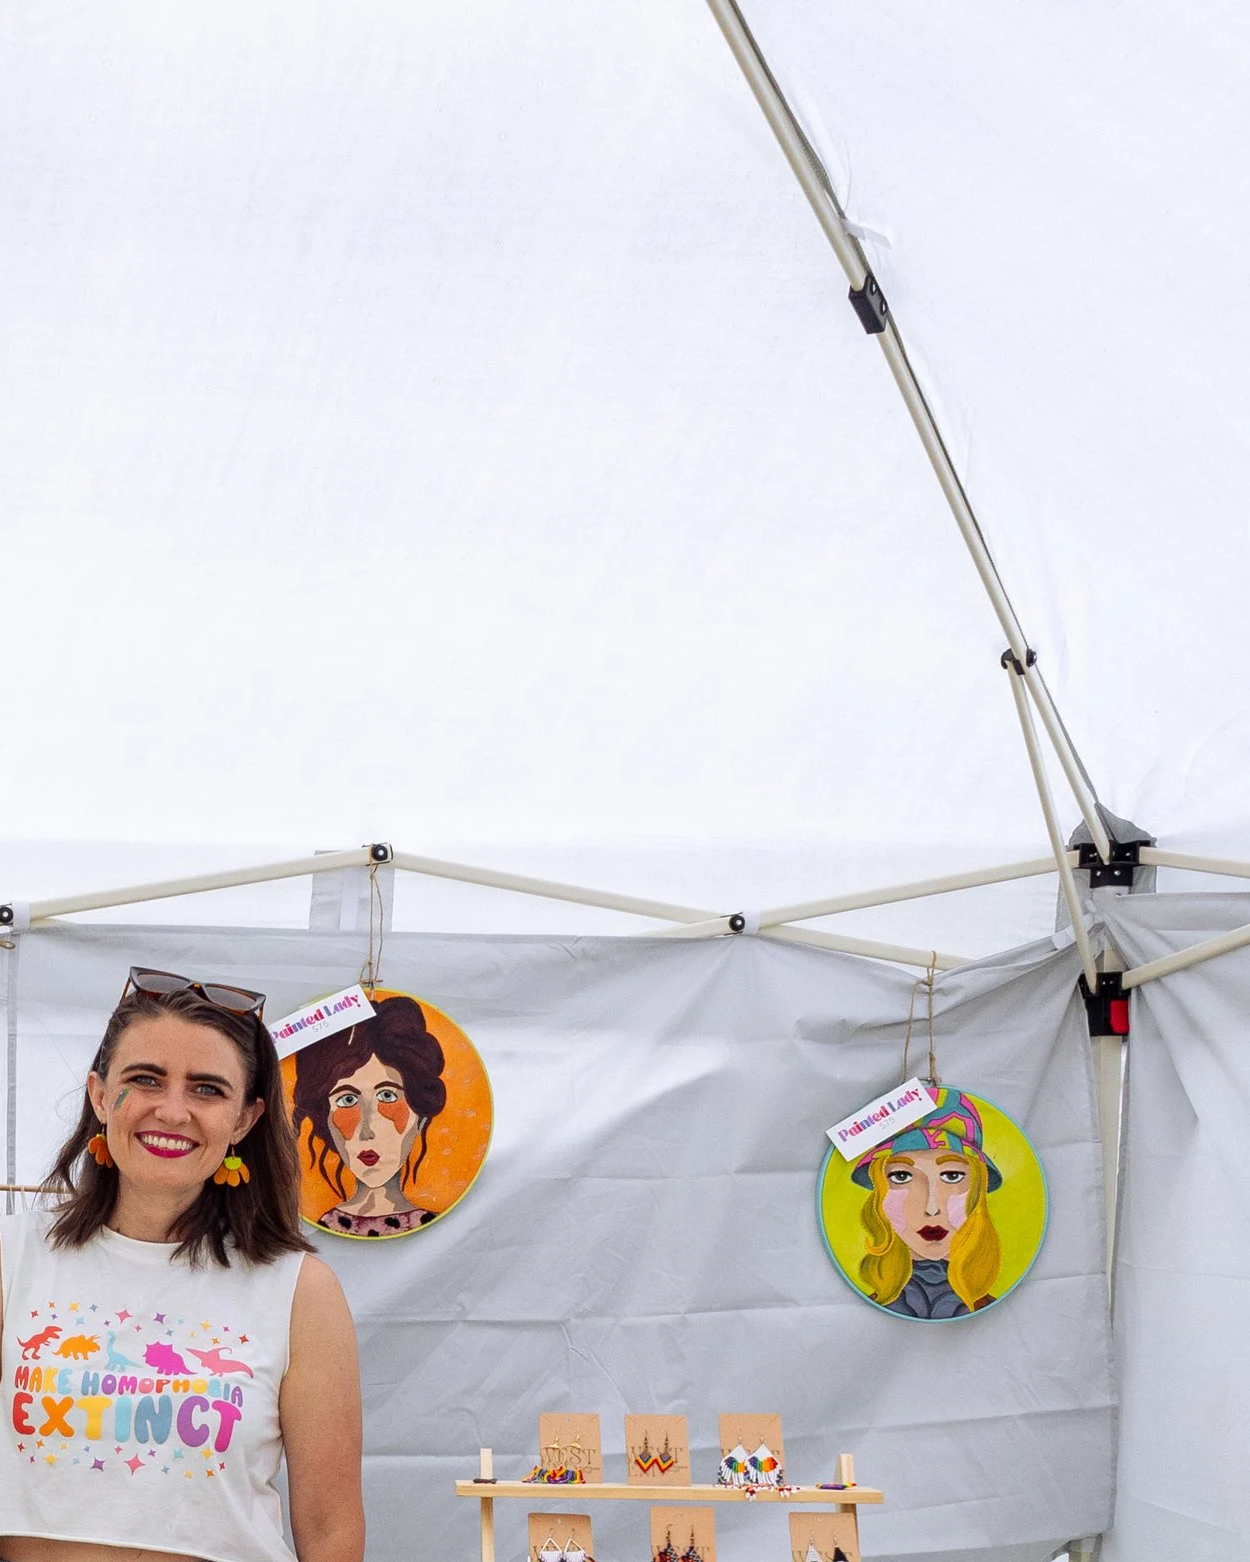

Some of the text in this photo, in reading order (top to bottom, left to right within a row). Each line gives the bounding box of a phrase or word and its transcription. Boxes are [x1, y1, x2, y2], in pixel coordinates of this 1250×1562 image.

[270, 994, 361, 1044] Painted Lady
[837, 1088, 922, 1142] Painted Lady
[14, 1365, 243, 1407] MAKE HOMOPHOBIA
[12, 1391, 242, 1453] EXTINCT
